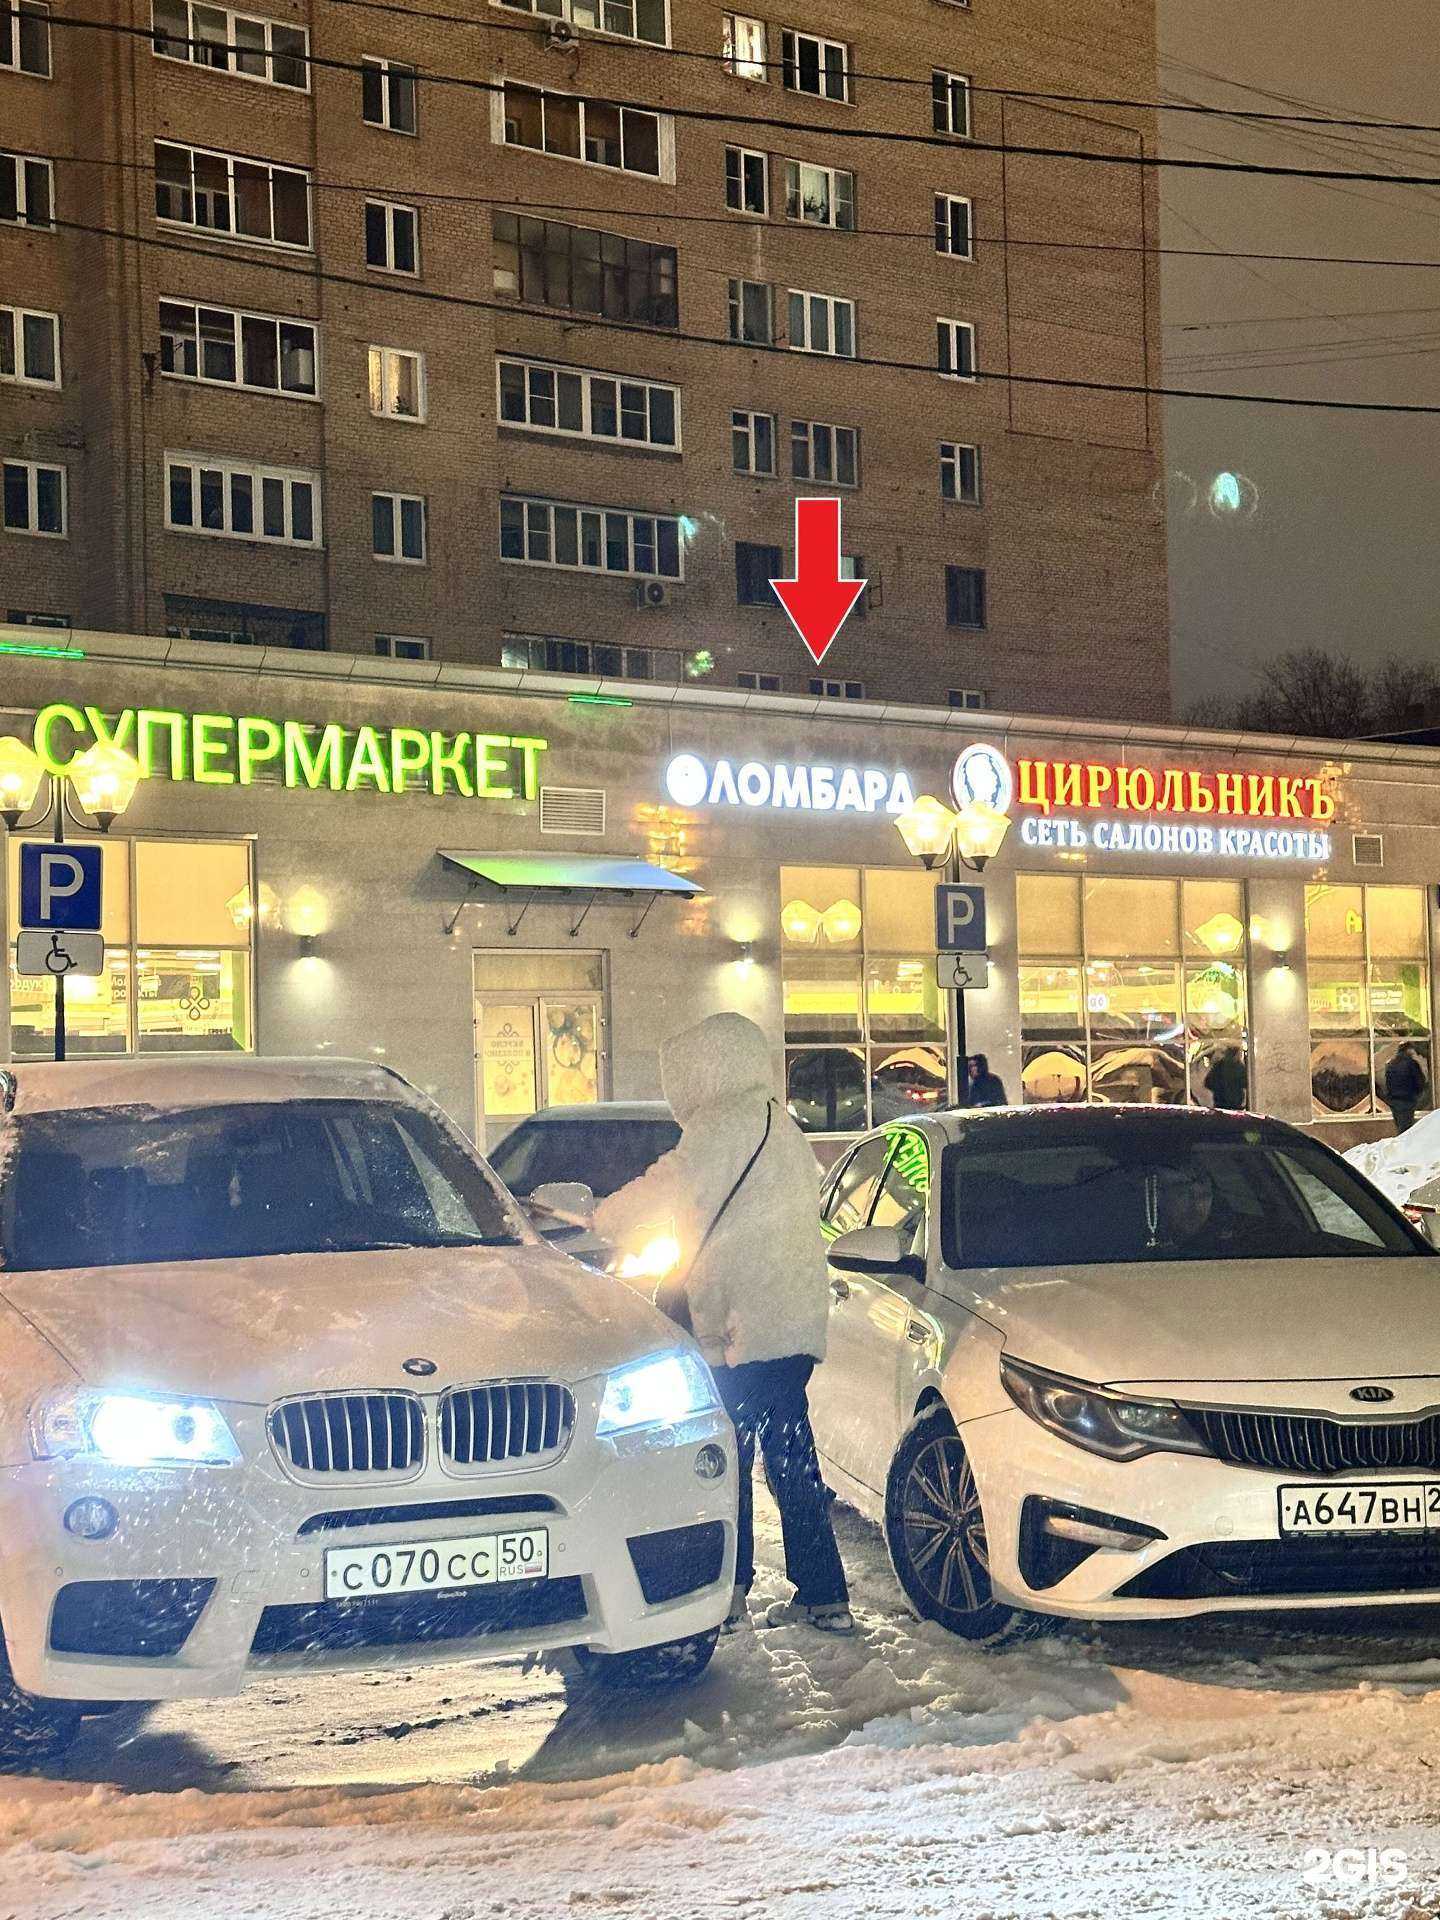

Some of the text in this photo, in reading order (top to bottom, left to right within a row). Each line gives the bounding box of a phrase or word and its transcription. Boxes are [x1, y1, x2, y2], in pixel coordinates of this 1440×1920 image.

[34, 703, 548, 801] СУПЕРМАРКЕТ
[708, 759, 916, 814] ЛОМБАРД
[1016, 759, 1336, 820] ЦИРЮЛЬНИКЪ
[1020, 818, 1331, 860] СЕТЬ САЛОНОВ КРАСОТЫ
[40, 853, 85, 920] P
[947, 892, 975, 944] P
[1357, 1387, 1390, 1399] KIA
[499, 1564, 524, 1577] RUS
[501, 1536, 534, 1564] 50
